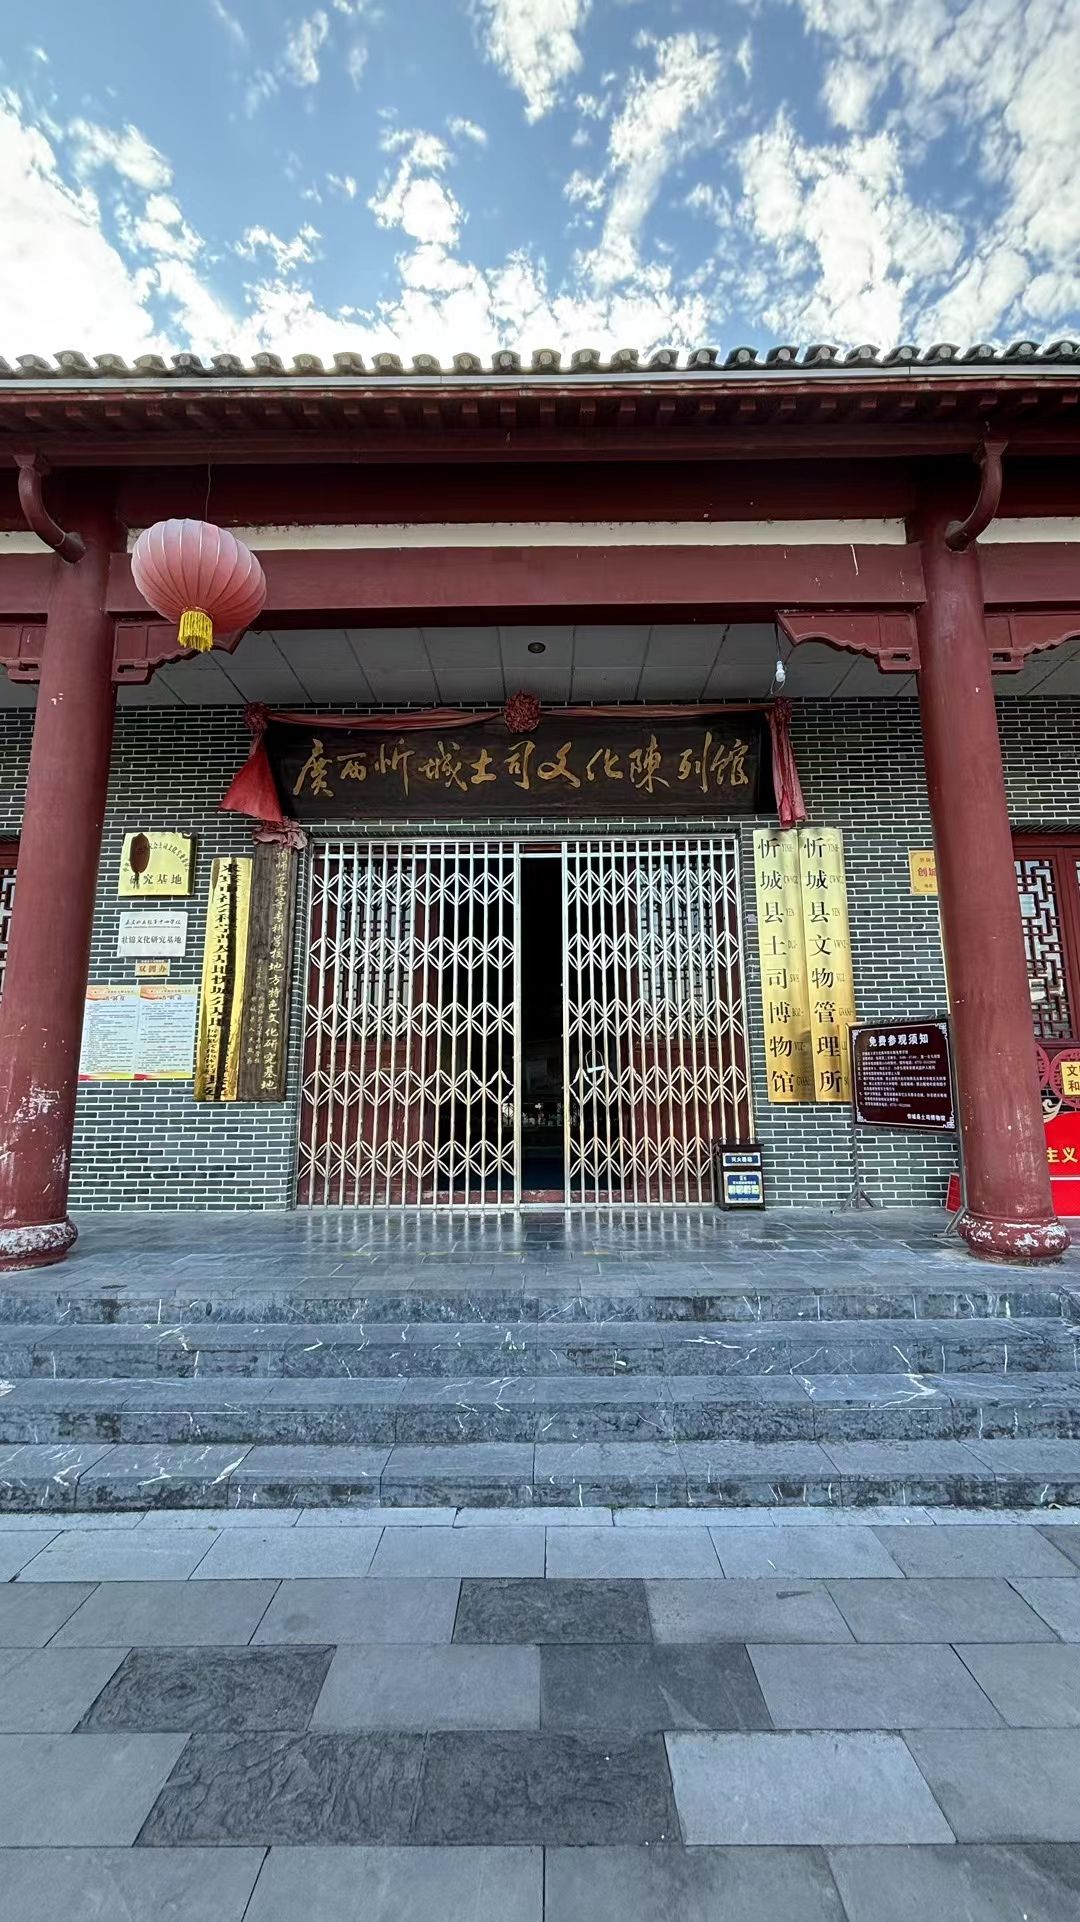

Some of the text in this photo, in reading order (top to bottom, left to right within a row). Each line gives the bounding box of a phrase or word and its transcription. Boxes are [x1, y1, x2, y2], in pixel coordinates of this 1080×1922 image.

[758, 837, 796, 1093] 忻城县土司博物馆
[804, 837, 843, 1093] 忻城县文物管理所
[868, 1033, 929, 1047] 免费参观须知
[1046, 1146, 1079, 1163] 主义
